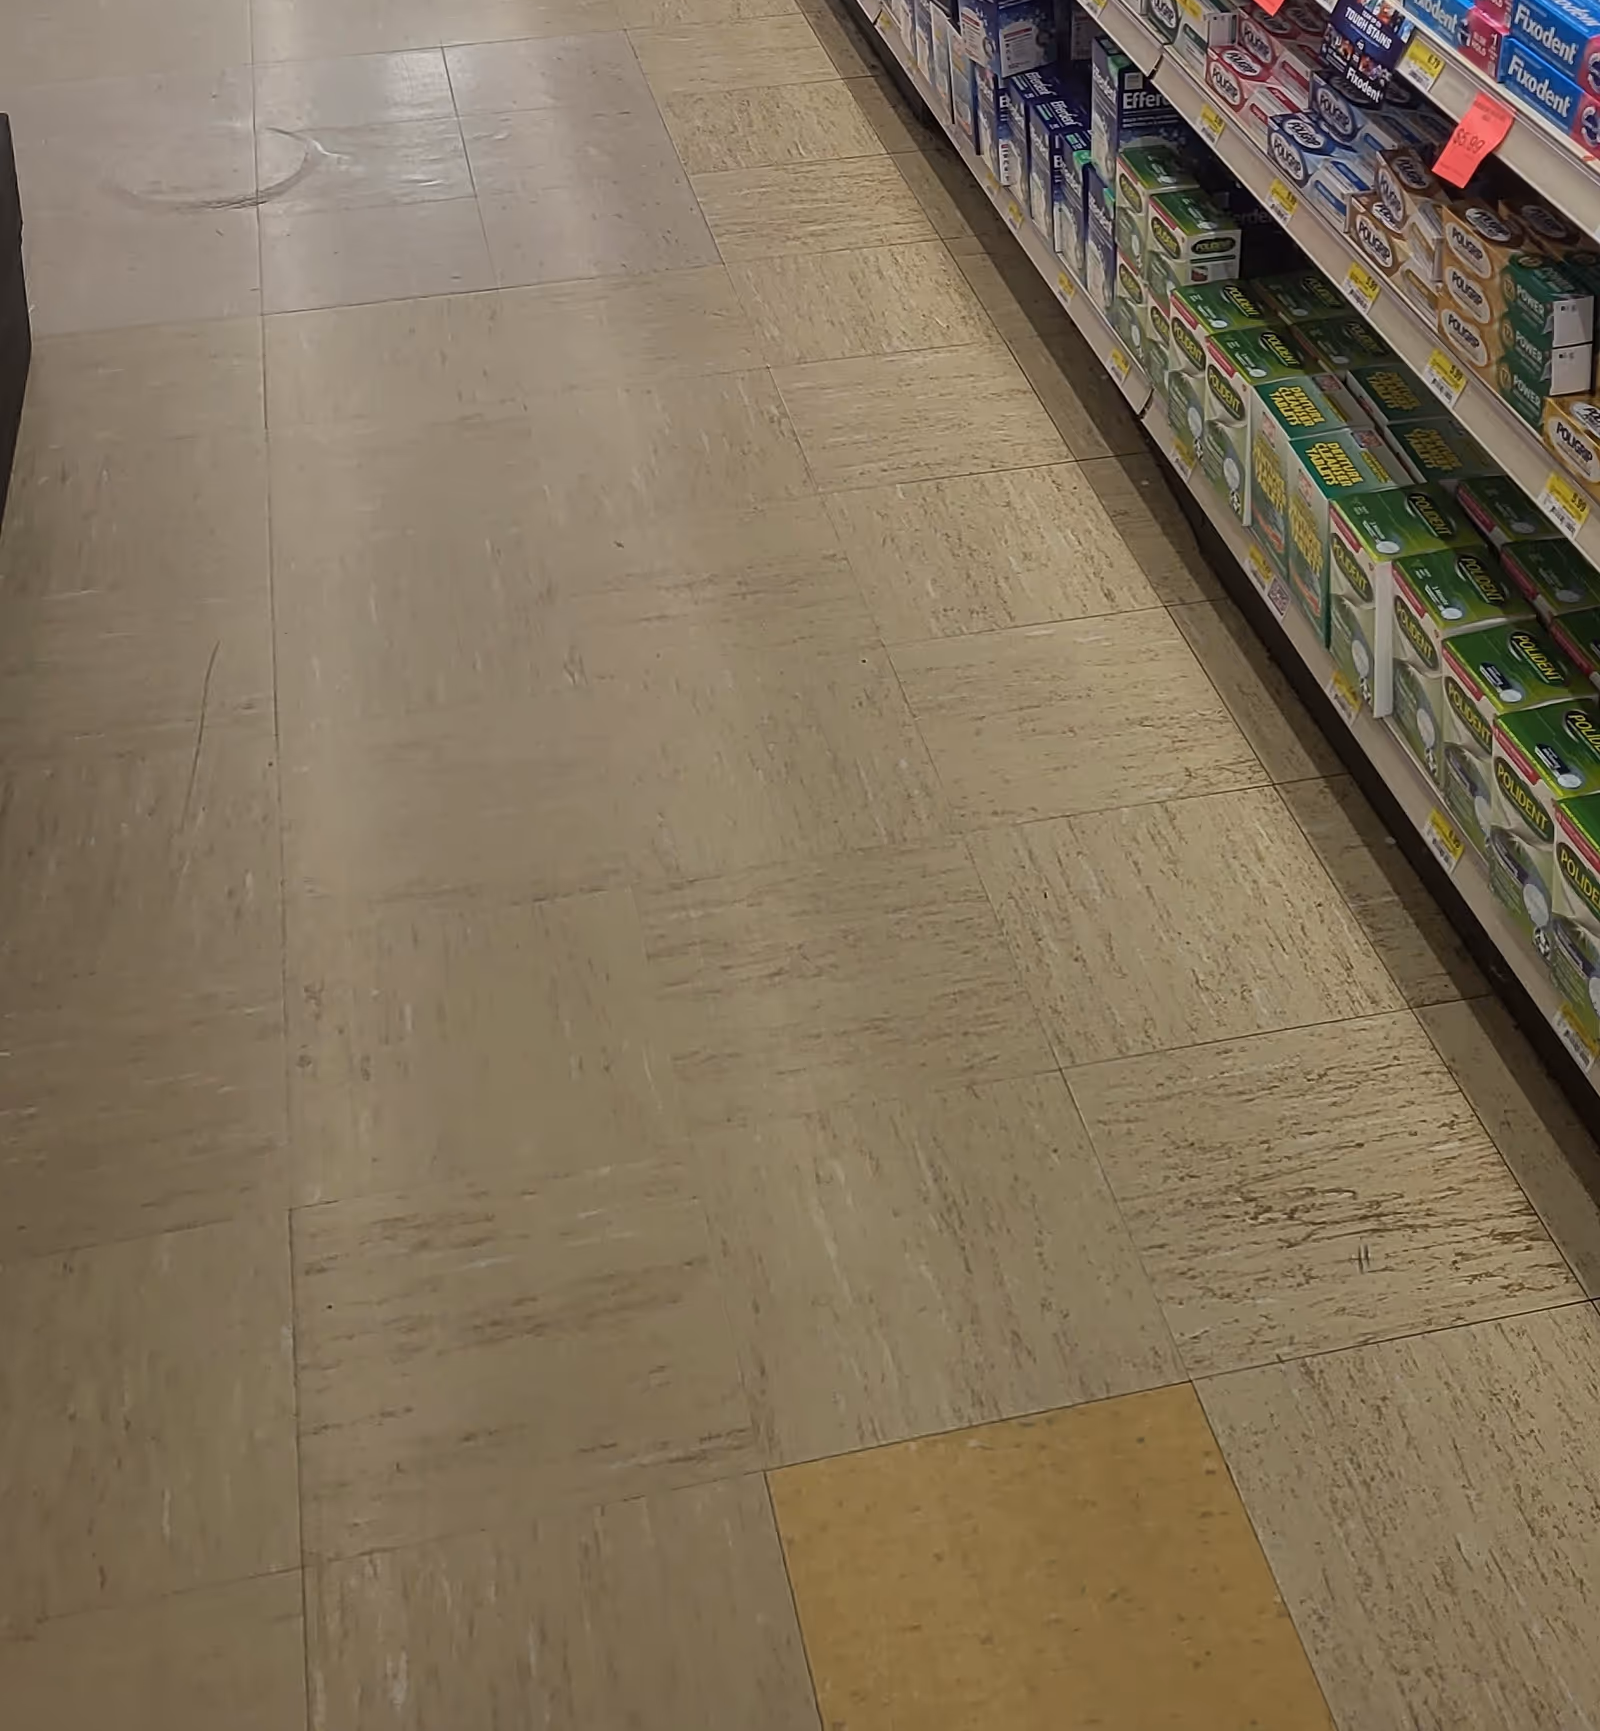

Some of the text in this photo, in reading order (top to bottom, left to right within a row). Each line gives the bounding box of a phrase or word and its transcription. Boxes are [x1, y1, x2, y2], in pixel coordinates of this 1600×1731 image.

[1345, 6, 1392, 49] TOUGH STAINS
[1513, 3, 1578, 65] Fixodent
[1346, 67, 1381, 103] Fixodent
[1507, 54, 1572, 118] Fixodent
[1273, 137, 1302, 175] POLIGRIP
[1453, 128, 1486, 154] $5.99
[1358, 219, 1391, 261] POLIGRIP
[1452, 226, 1483, 260] POLIGRIP
[1452, 271, 1483, 306] POLIGRIP
[1516, 284, 1545, 314] POWER
[1173, 322, 1203, 362] POLIDENT
[1264, 334, 1300, 366] POLIDENT
[1448, 314, 1480, 349] POLIGRIP
[1515, 330, 1543, 362] POWER
[1209, 369, 1241, 413] POLIDENT
[1269, 391, 1301, 426] TABLETS
[1278, 386, 1315, 427] CLEANSER
[1290, 386, 1326, 424] DENTURE
[1513, 374, 1541, 406] POWER
[1326, 442, 1364, 483] DENTURE
[1556, 421, 1593, 463] POLIGRIP
[1305, 447, 1339, 486] TABLETS
[1314, 442, 1352, 487] CLEANSER
[1411, 495, 1453, 536] POLIDENT
[1571, 489, 1587, 512] 5.99
[1459, 558, 1506, 602] POLIDENT
[1396, 604, 1434, 658] POLIDENT
[1515, 634, 1565, 683] POLIDENT
[1447, 684, 1493, 746] POLIDENT
[1497, 766, 1548, 830] POLIDENT
[1560, 848, 1600, 910] POLIDE
